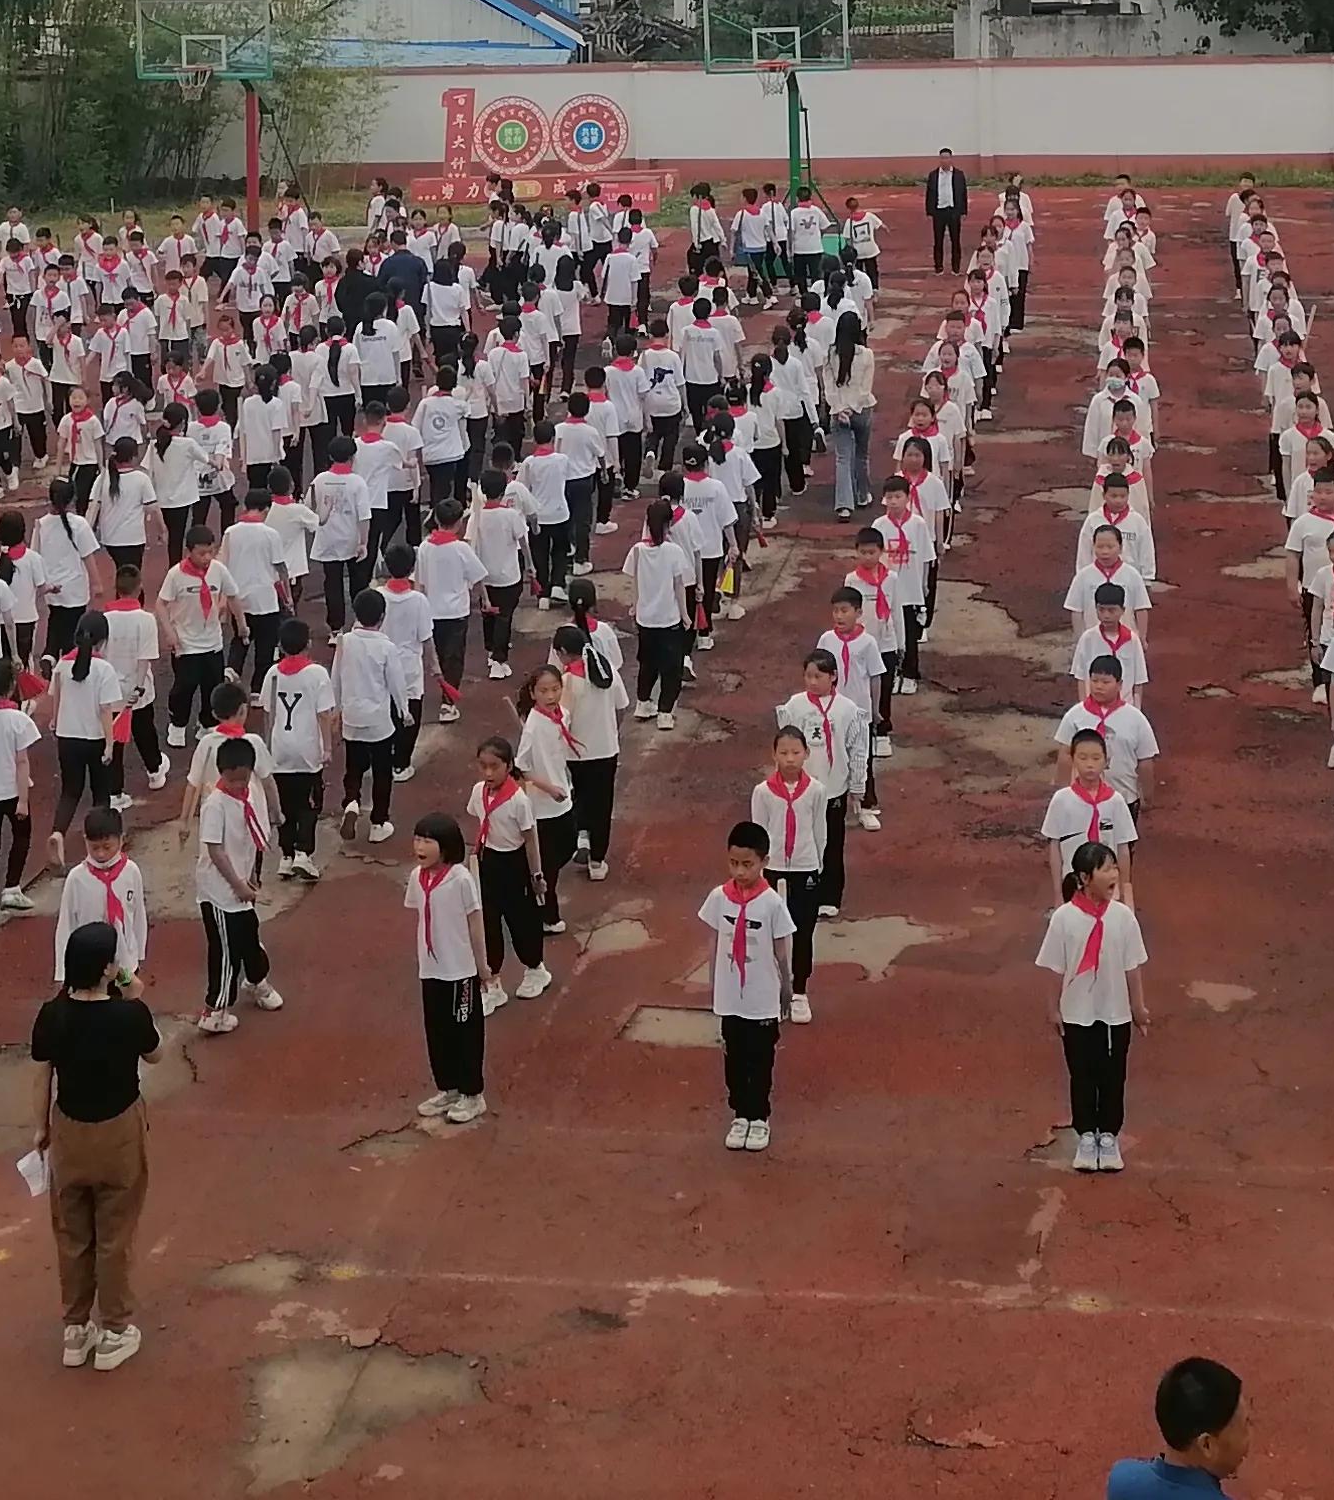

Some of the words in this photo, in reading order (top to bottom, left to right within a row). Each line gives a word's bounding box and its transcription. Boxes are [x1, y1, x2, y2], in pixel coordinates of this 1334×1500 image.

[450, 94, 468, 171] 百年大计
[277, 691, 303, 732] Y
